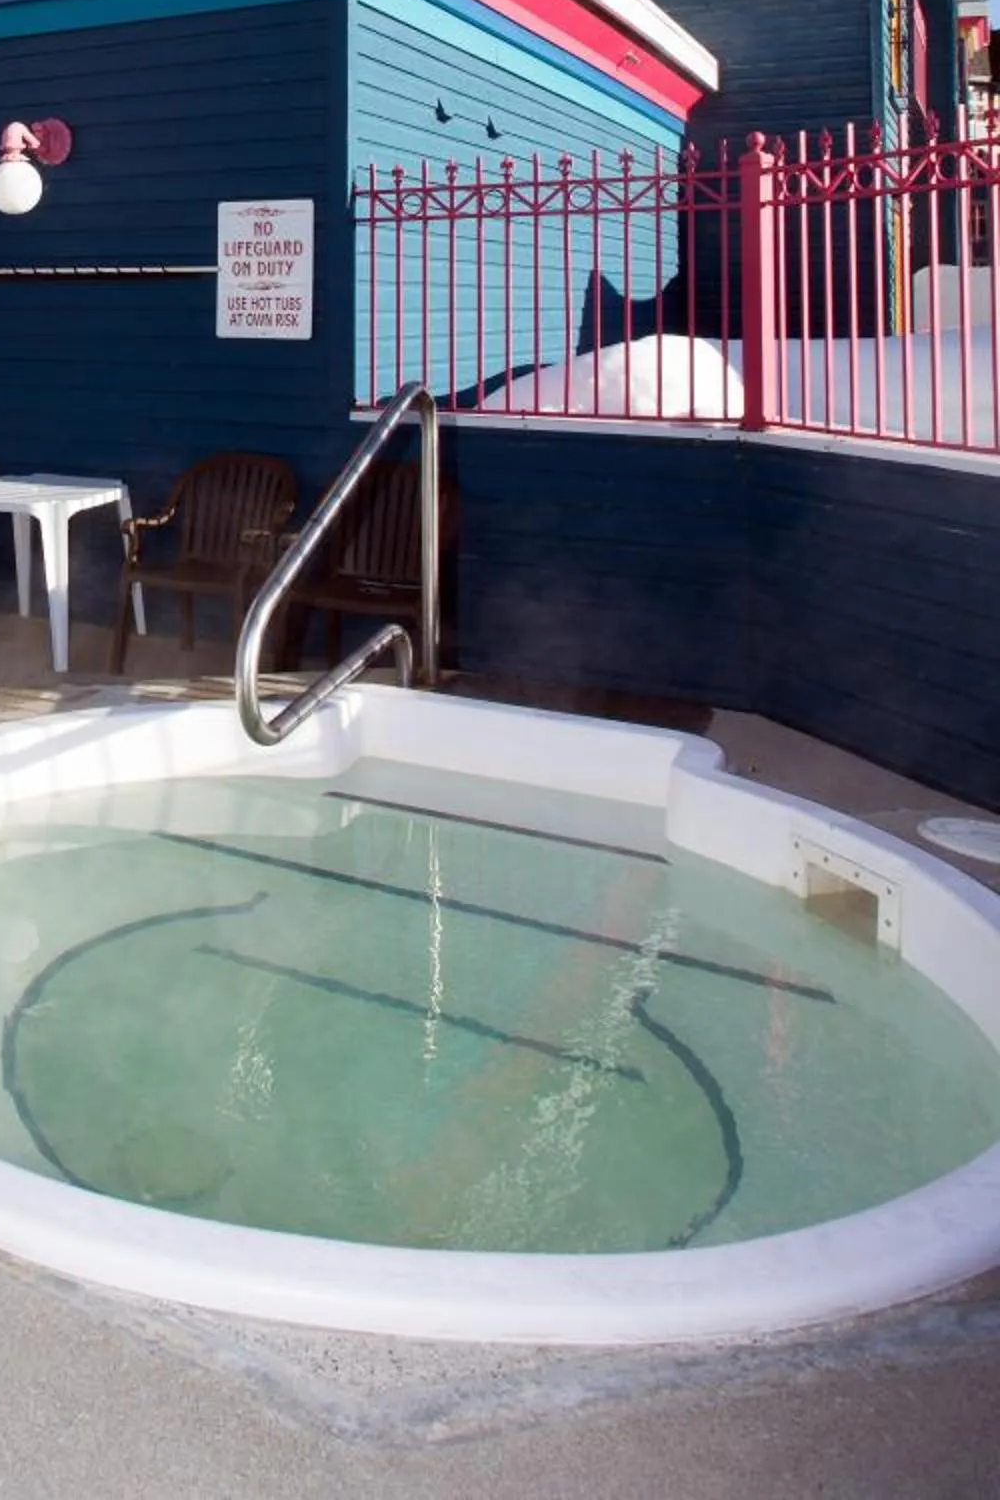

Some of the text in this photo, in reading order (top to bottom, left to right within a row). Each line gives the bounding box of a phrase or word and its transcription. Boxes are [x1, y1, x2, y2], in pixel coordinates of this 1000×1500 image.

[253, 221, 273, 236] NO
[224, 241, 303, 257] LIFEGUARD
[231, 261, 294, 276] ON DUTY
[227, 297, 303, 311] USE HOT TUBS
[229, 313, 300, 327] AT OWN RISK
